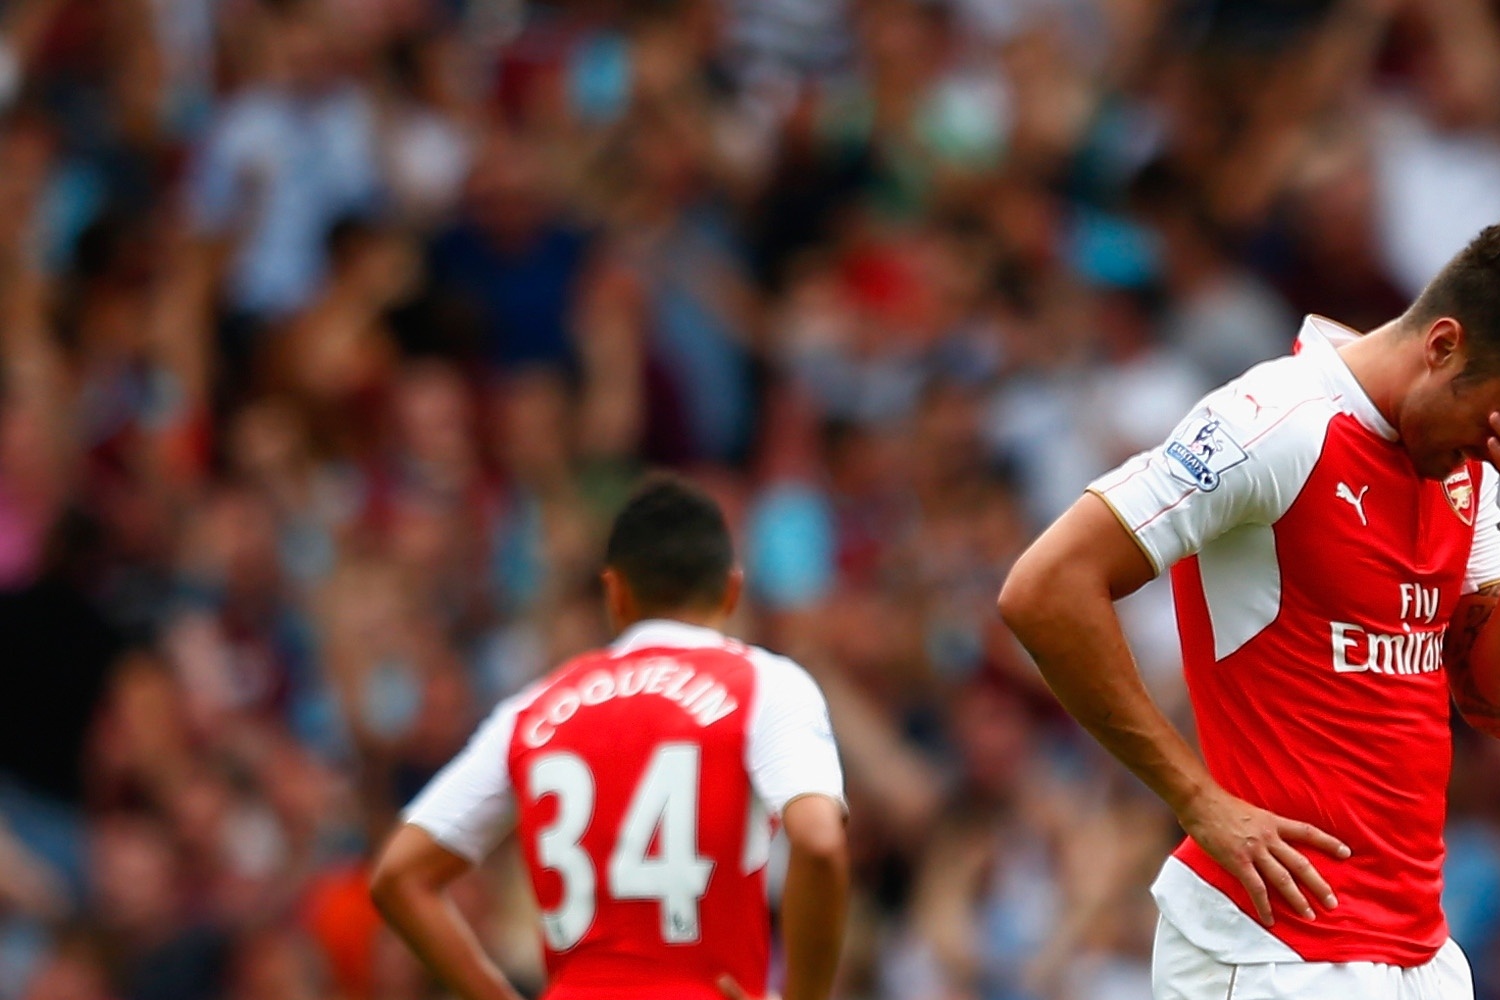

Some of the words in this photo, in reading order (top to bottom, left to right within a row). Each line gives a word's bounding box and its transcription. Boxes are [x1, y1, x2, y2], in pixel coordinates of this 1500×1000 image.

[1399, 582, 1439, 624] Fly
[1329, 620, 1447, 674] Emira
[522, 656, 739, 749] COQUELIN
[526, 740, 717, 954] 34
